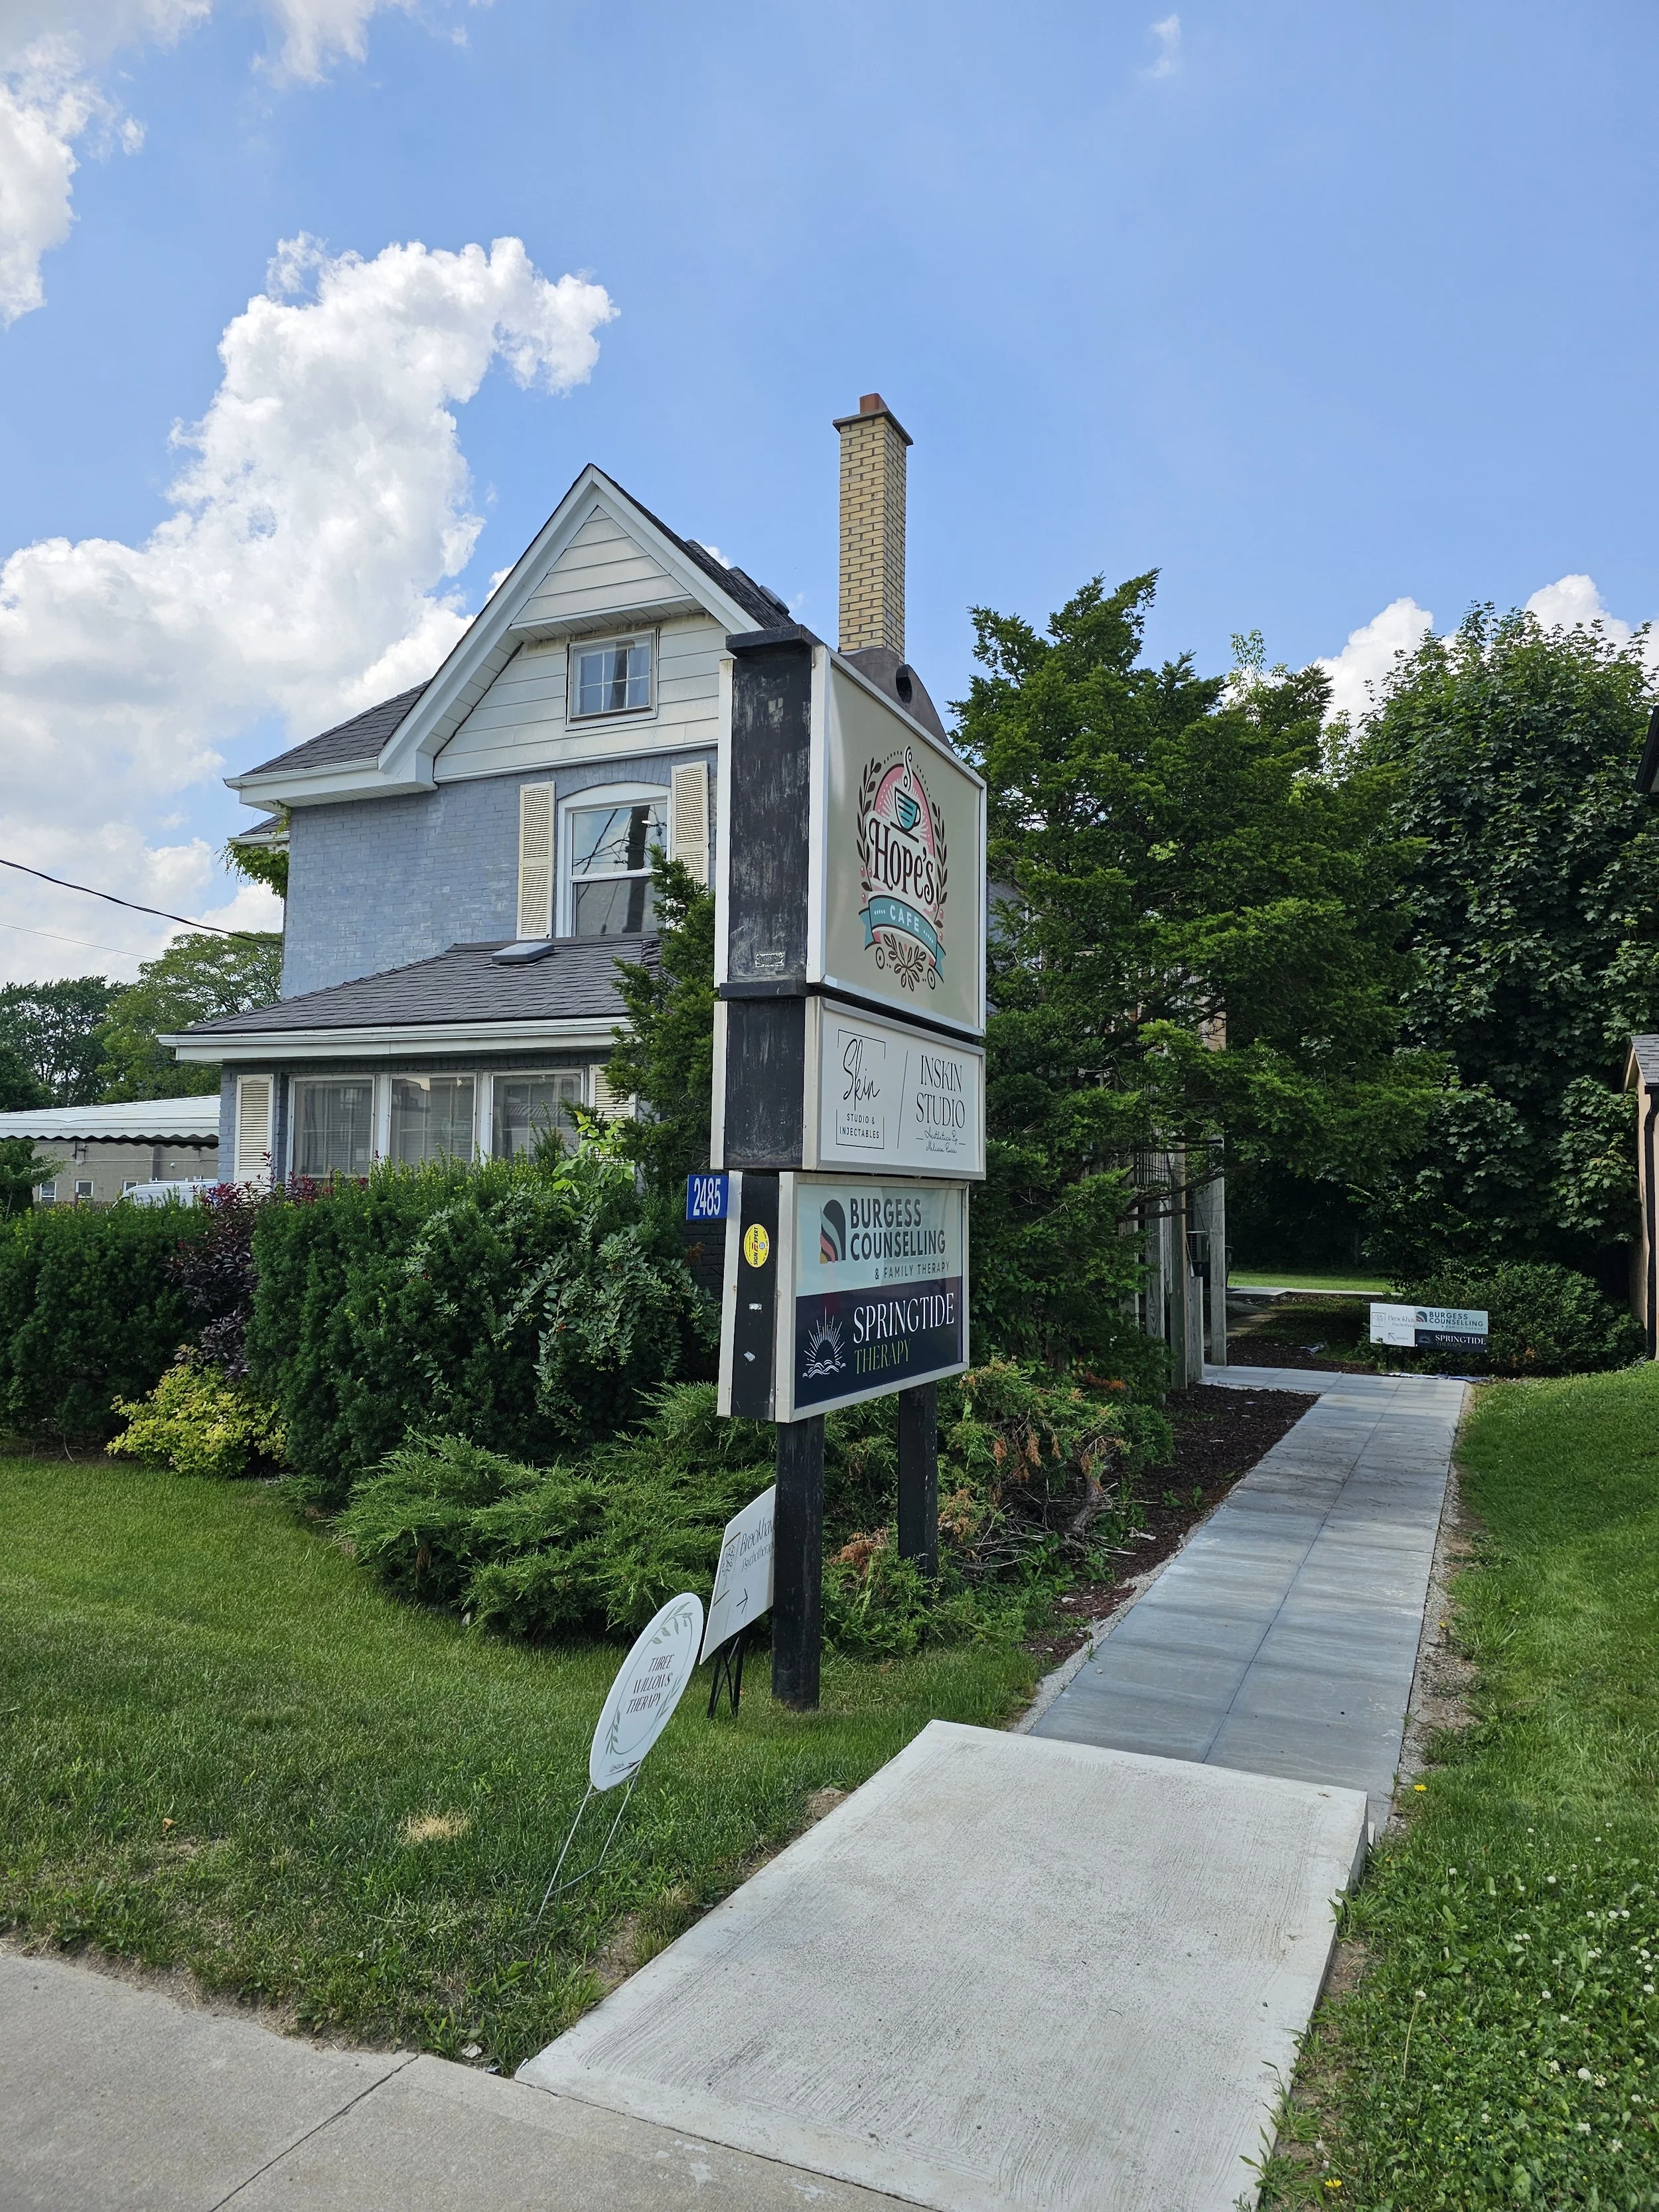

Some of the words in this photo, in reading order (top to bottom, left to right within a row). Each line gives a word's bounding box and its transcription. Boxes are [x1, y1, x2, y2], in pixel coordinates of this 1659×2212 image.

[869, 817, 934, 905] Hope's
[889, 905, 920, 933] CAFE
[843, 1038, 881, 1111] Skin
[920, 1055, 962, 1092] INSKIN
[847, 1113, 869, 1124] STUDIO
[916, 1092, 965, 1129] STUDIO
[839, 1126, 880, 1139] INJECTABLES
[693, 1177, 721, 1217] 2485
[850, 1198, 922, 1229] BURGESS
[850, 1229, 946, 1262] COUNSELLING
[875, 1268, 880, 1280] &
[884, 1264, 914, 1279] FAMILY
[917, 1261, 950, 1276] THERAPY
[853, 1292, 955, 1344] SPRINGTIDE
[1429, 1311, 1469, 1320] BURGESS
[1429, 1317, 1484, 1327] COUNSELLING
[1435, 1334, 1486, 1345] SPRINGTIDE
[854, 1338, 911, 1374] THERAPY
[648, 1654, 675, 1672] THREE
[633, 1672, 673, 1694] WILLOWS
[626, 1692, 661, 1714] THERAPY
